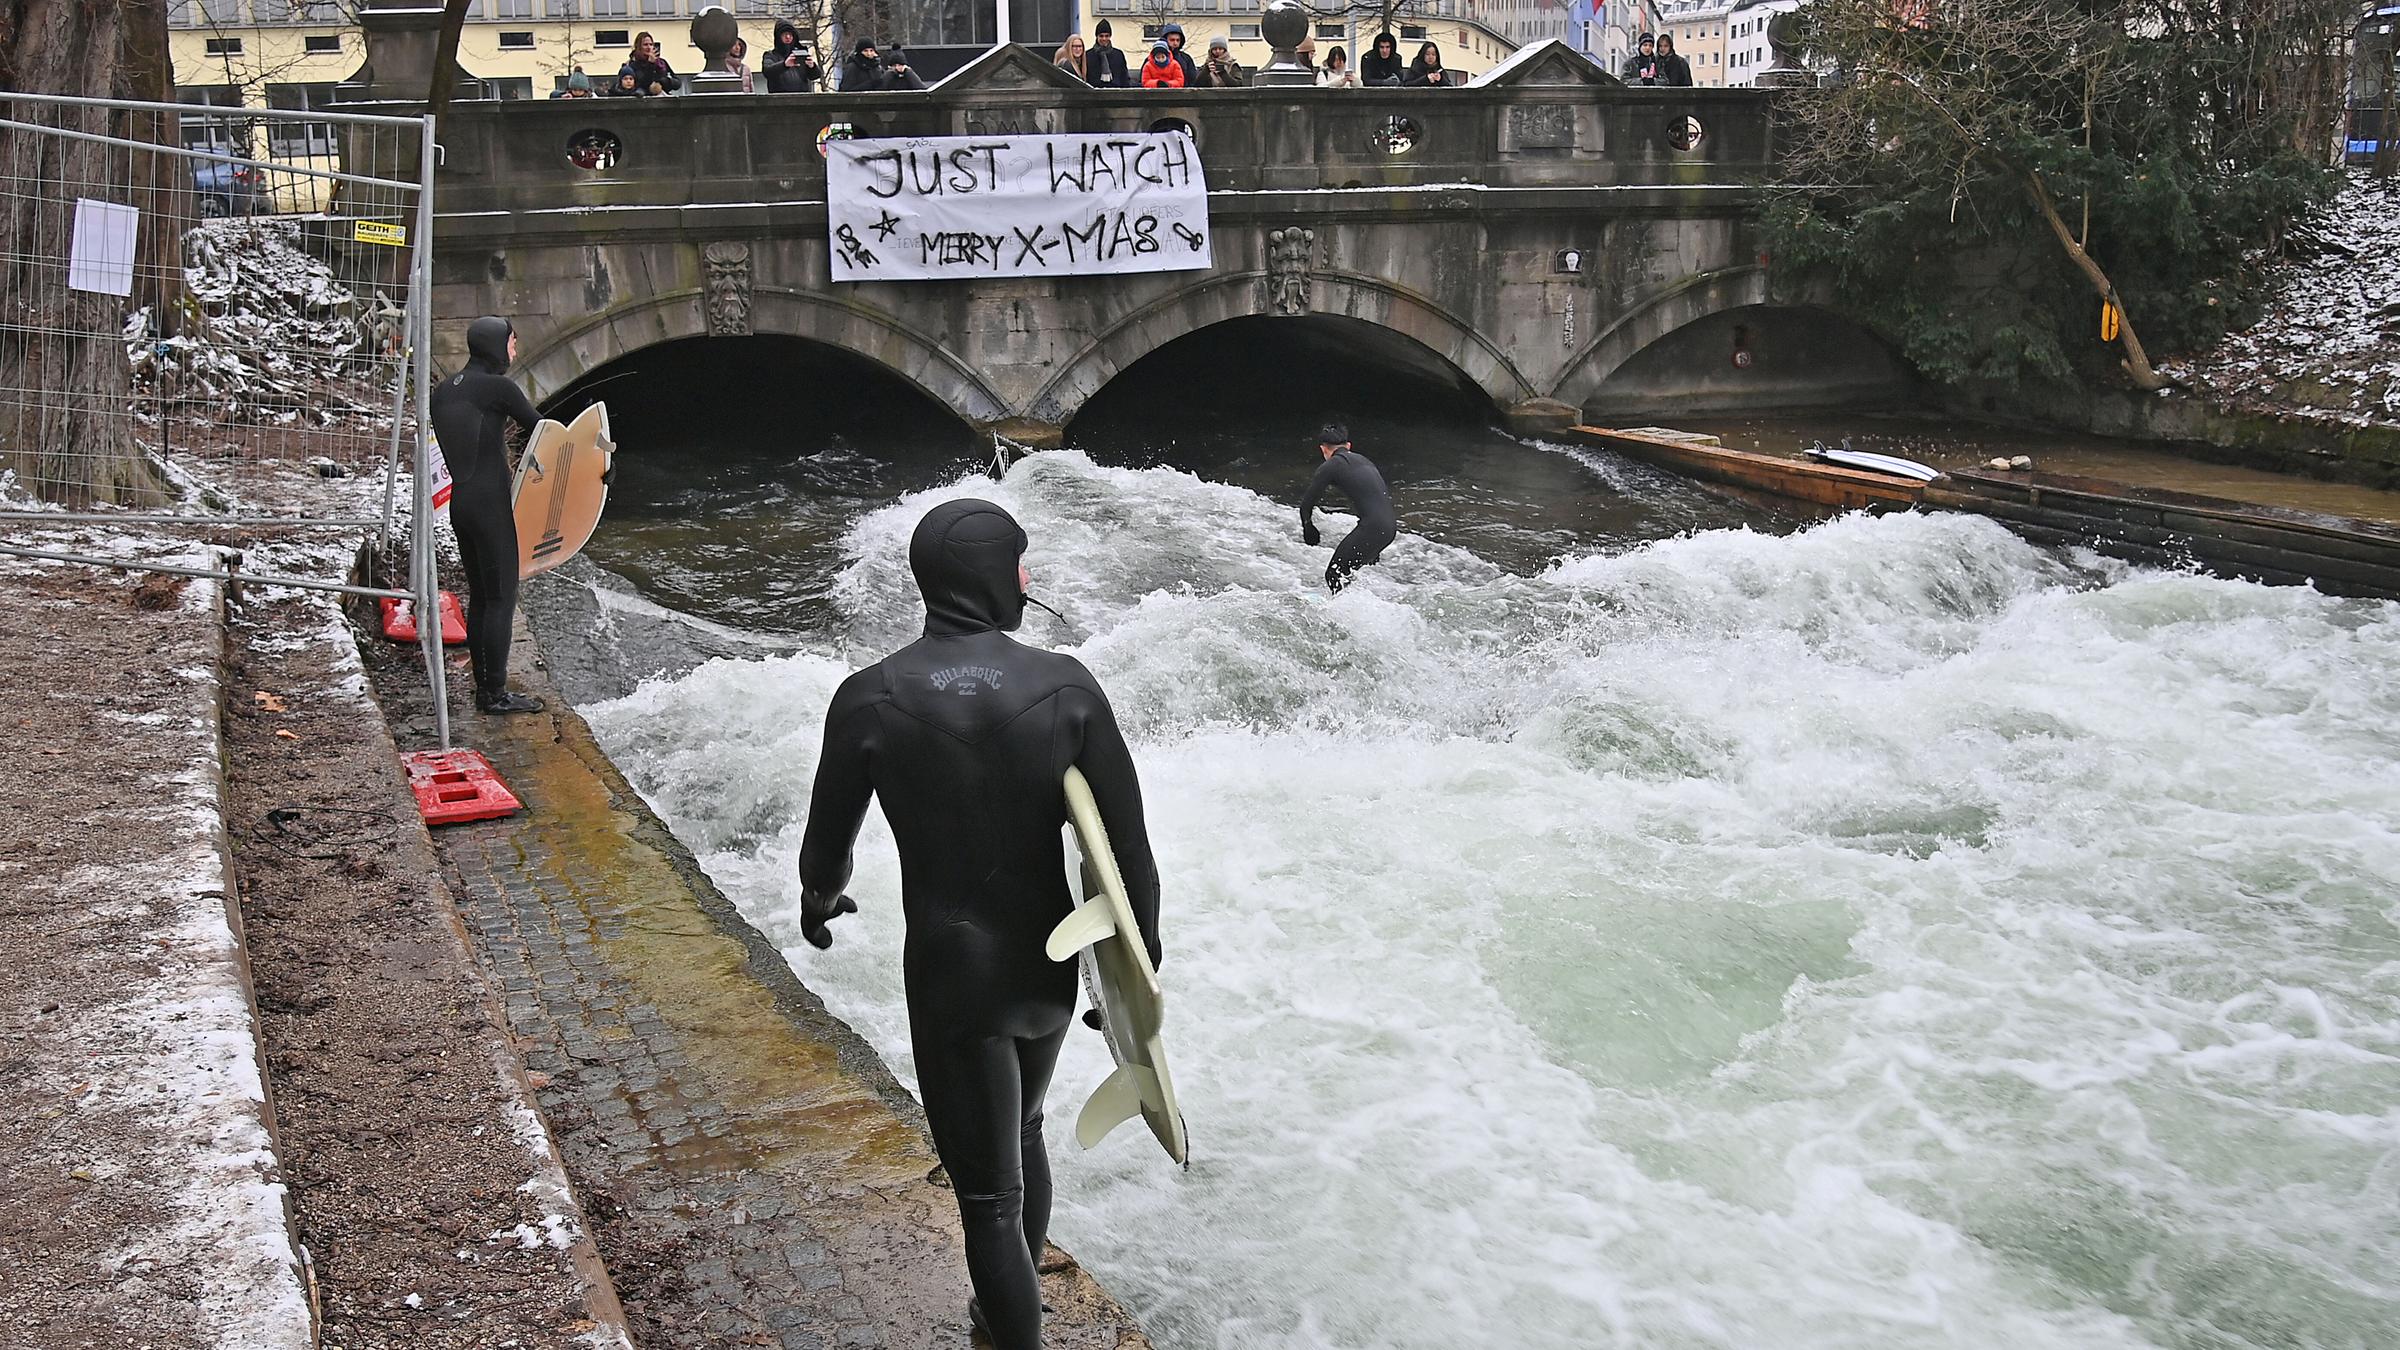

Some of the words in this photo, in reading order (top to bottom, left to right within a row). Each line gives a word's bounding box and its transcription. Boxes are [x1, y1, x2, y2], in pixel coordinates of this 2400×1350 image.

[860, 143, 1010, 198] JUST
[1047, 136, 1189, 193] WATCH
[358, 223, 389, 233] GEITH
[920, 231, 1004, 270] MERRY
[1014, 211, 1159, 267] X-MAS
[930, 666, 1003, 691] BILLABONG
